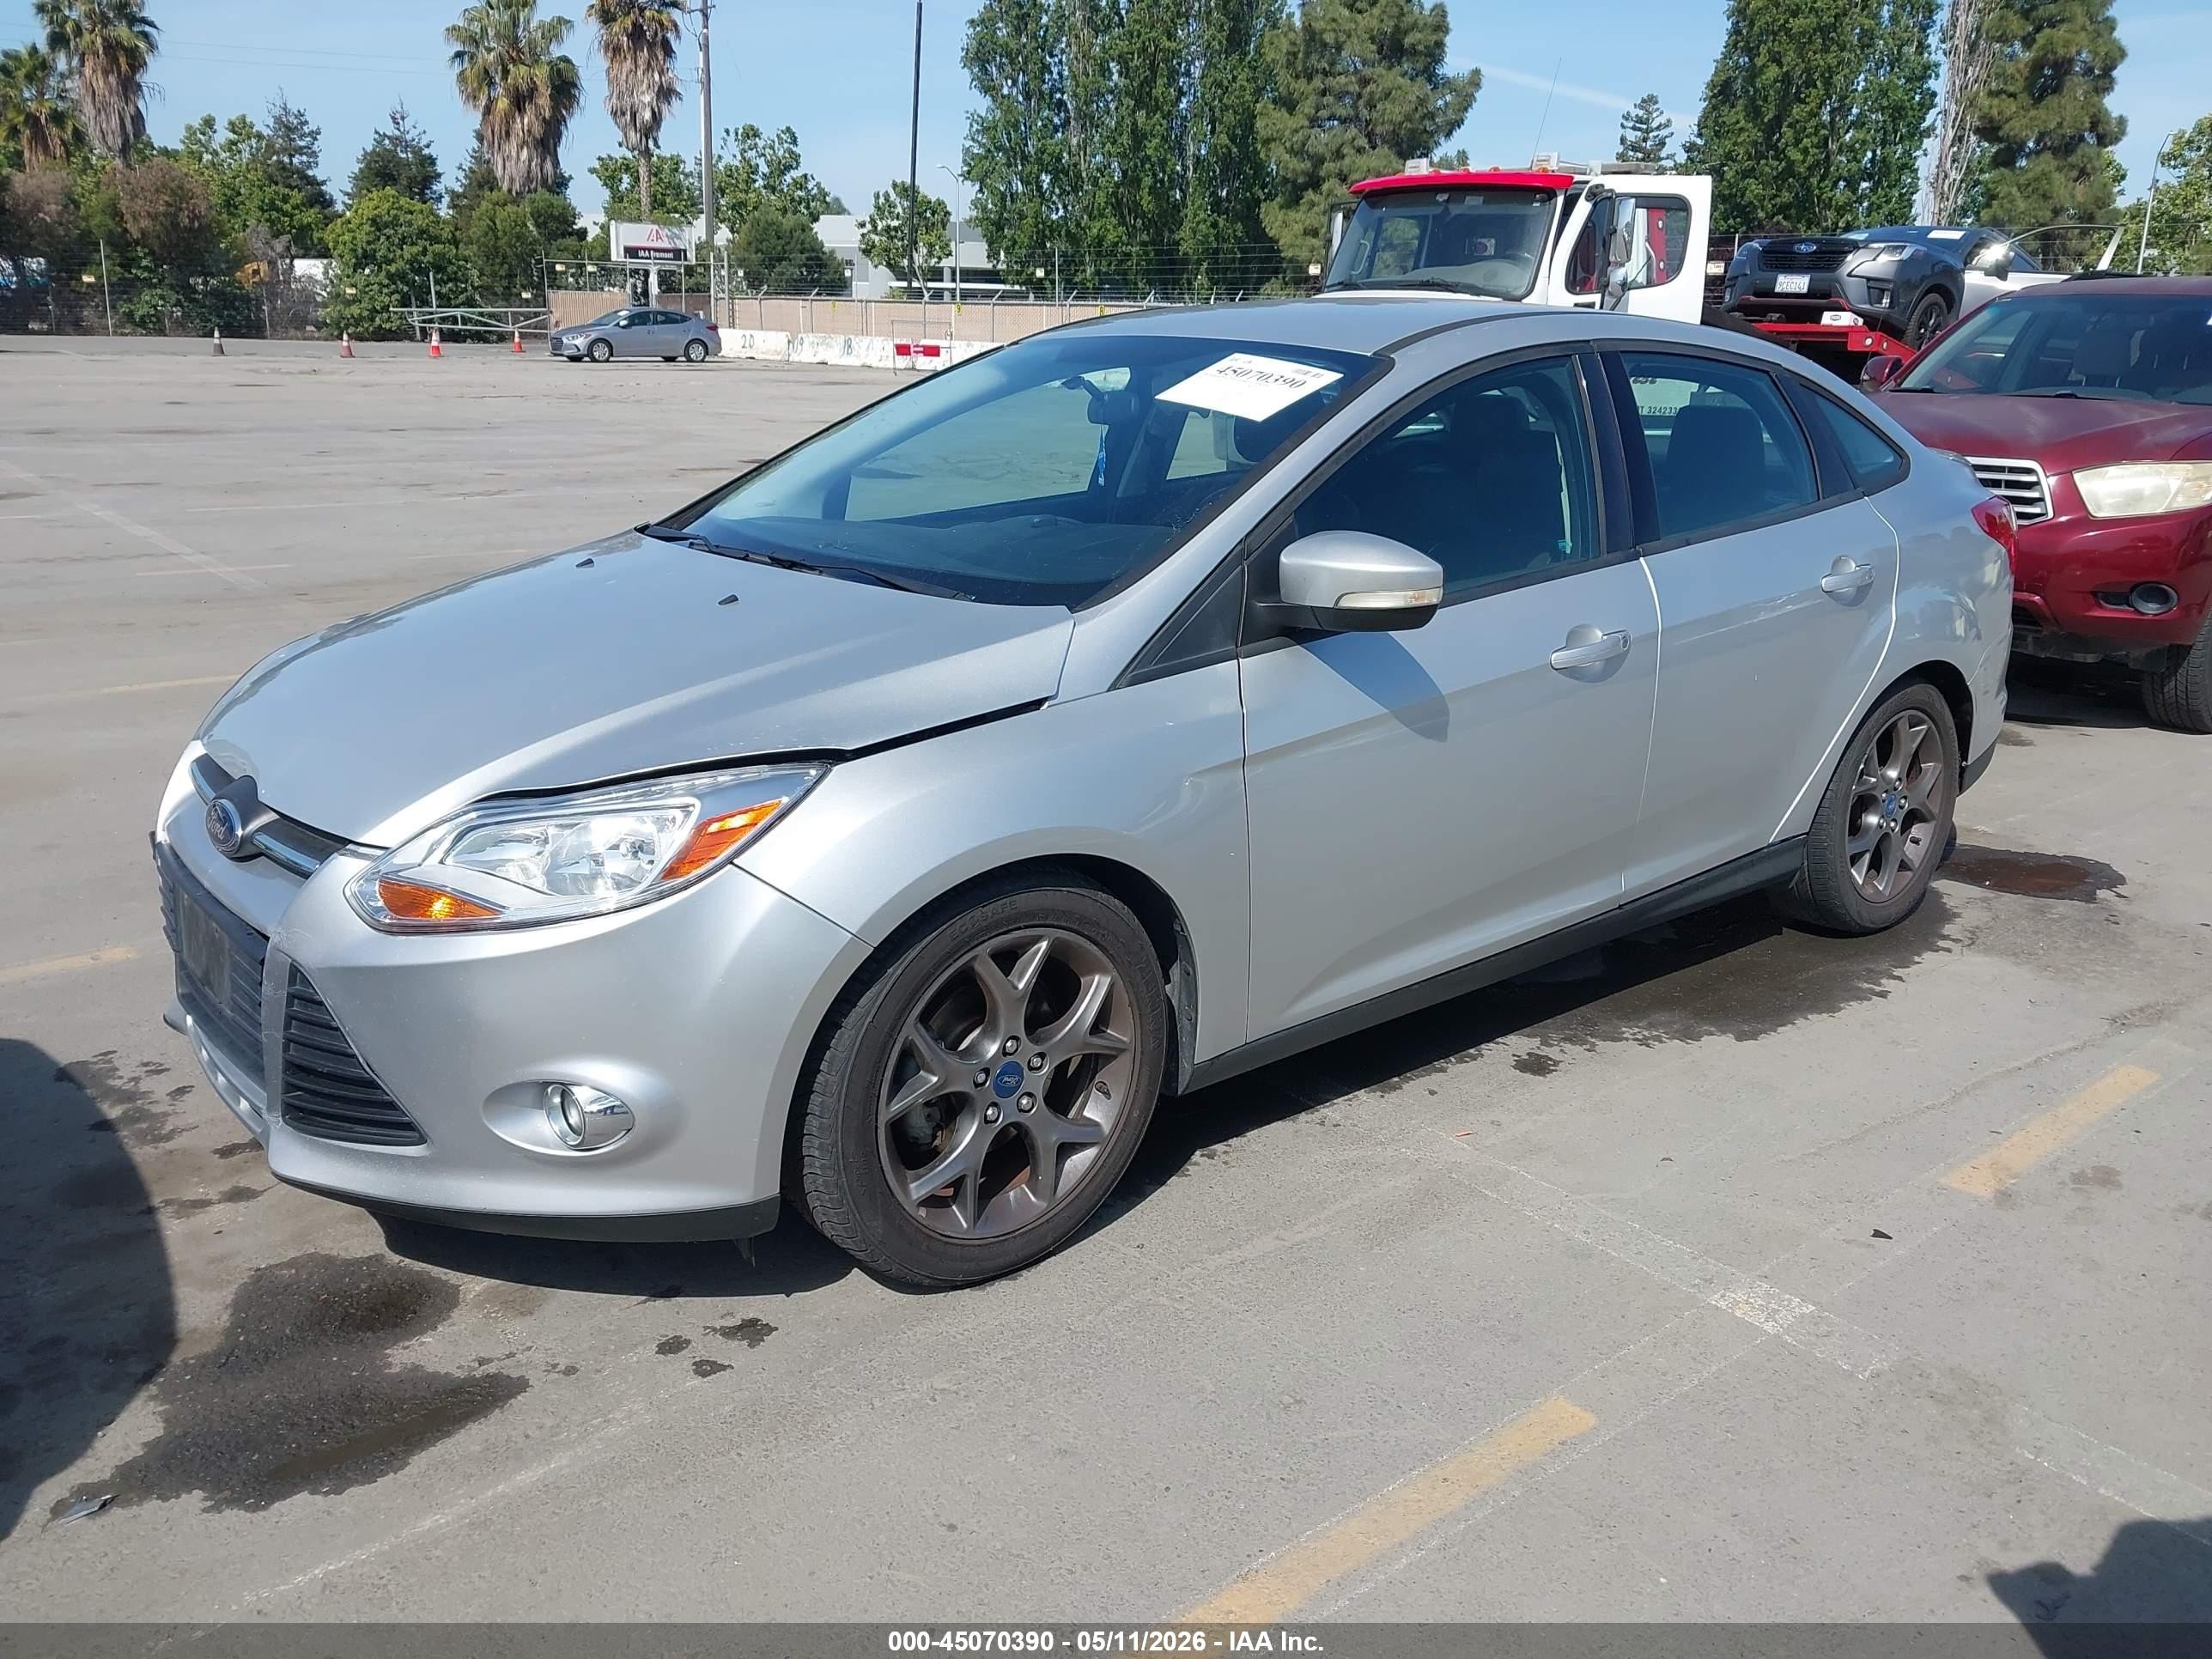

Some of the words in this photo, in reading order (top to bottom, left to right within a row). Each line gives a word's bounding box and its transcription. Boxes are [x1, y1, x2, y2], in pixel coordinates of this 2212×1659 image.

[638, 249, 650, 258] IAA
[741, 333, 755, 349] 20
[1216, 365, 1307, 389] 45070390
[208, 803, 228, 840] Ford
